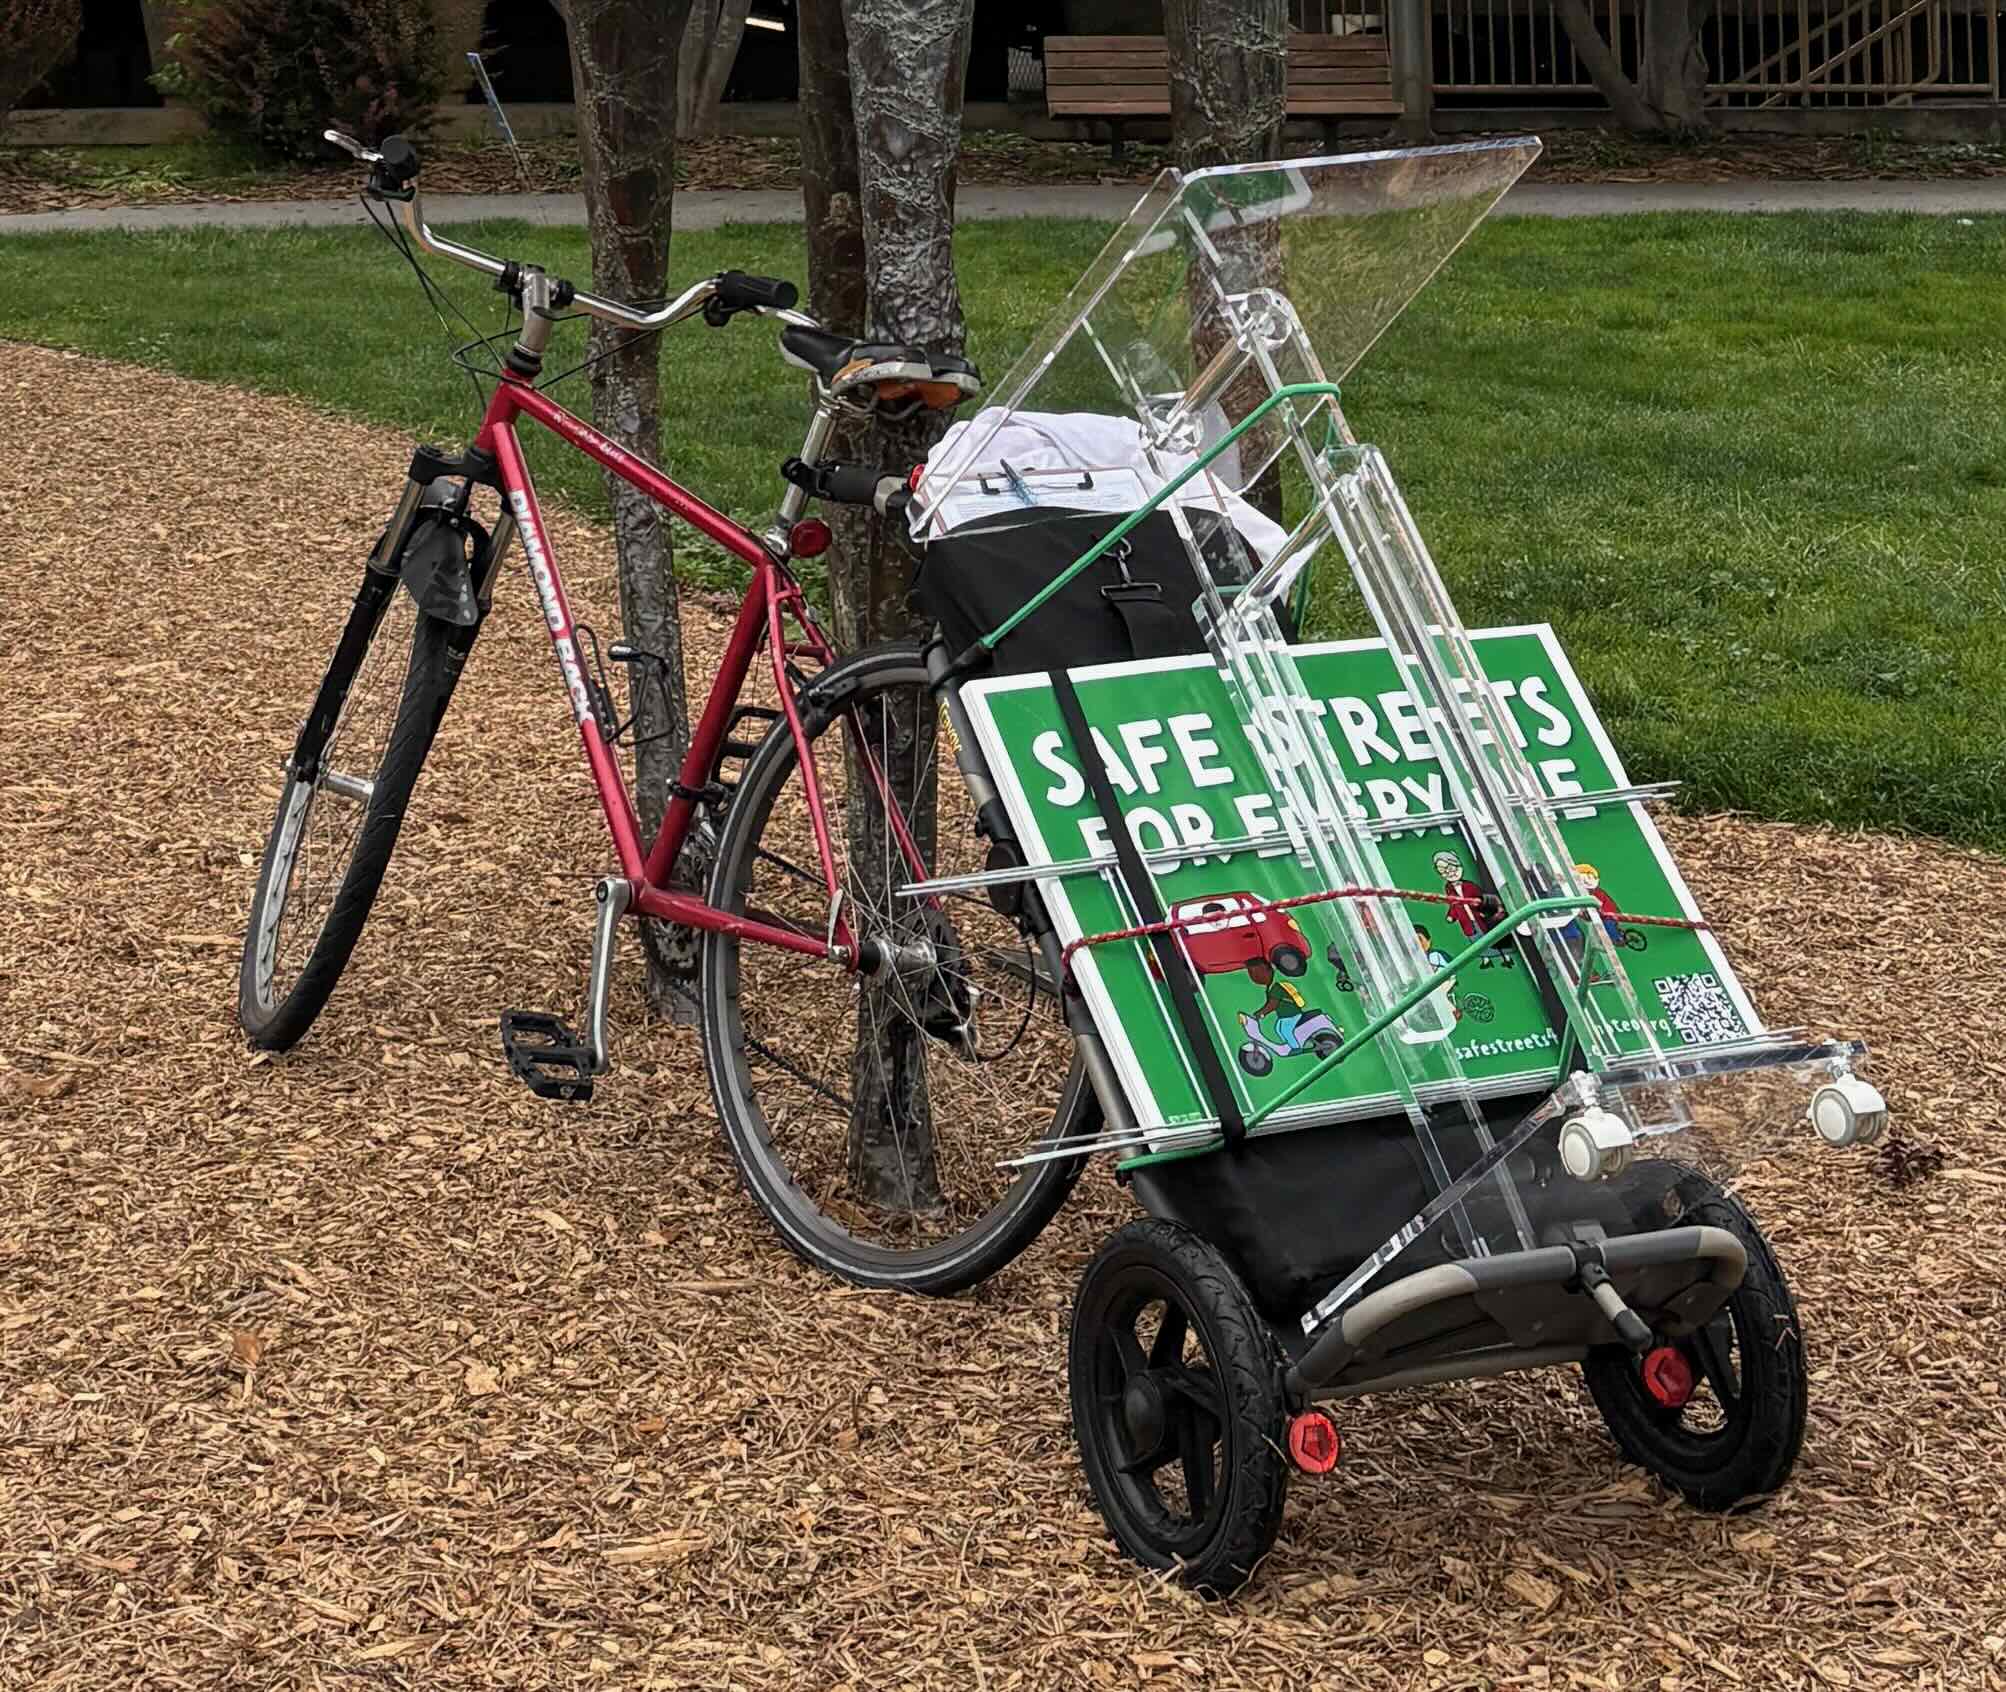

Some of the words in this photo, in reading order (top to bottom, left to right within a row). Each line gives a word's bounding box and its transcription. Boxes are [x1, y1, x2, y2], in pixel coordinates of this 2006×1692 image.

[509, 489, 566, 631] DIAMOND
[555, 637, 596, 722] BACK
[1032, 713, 1235, 807] SAFE
[1077, 803, 1232, 881] FOR
